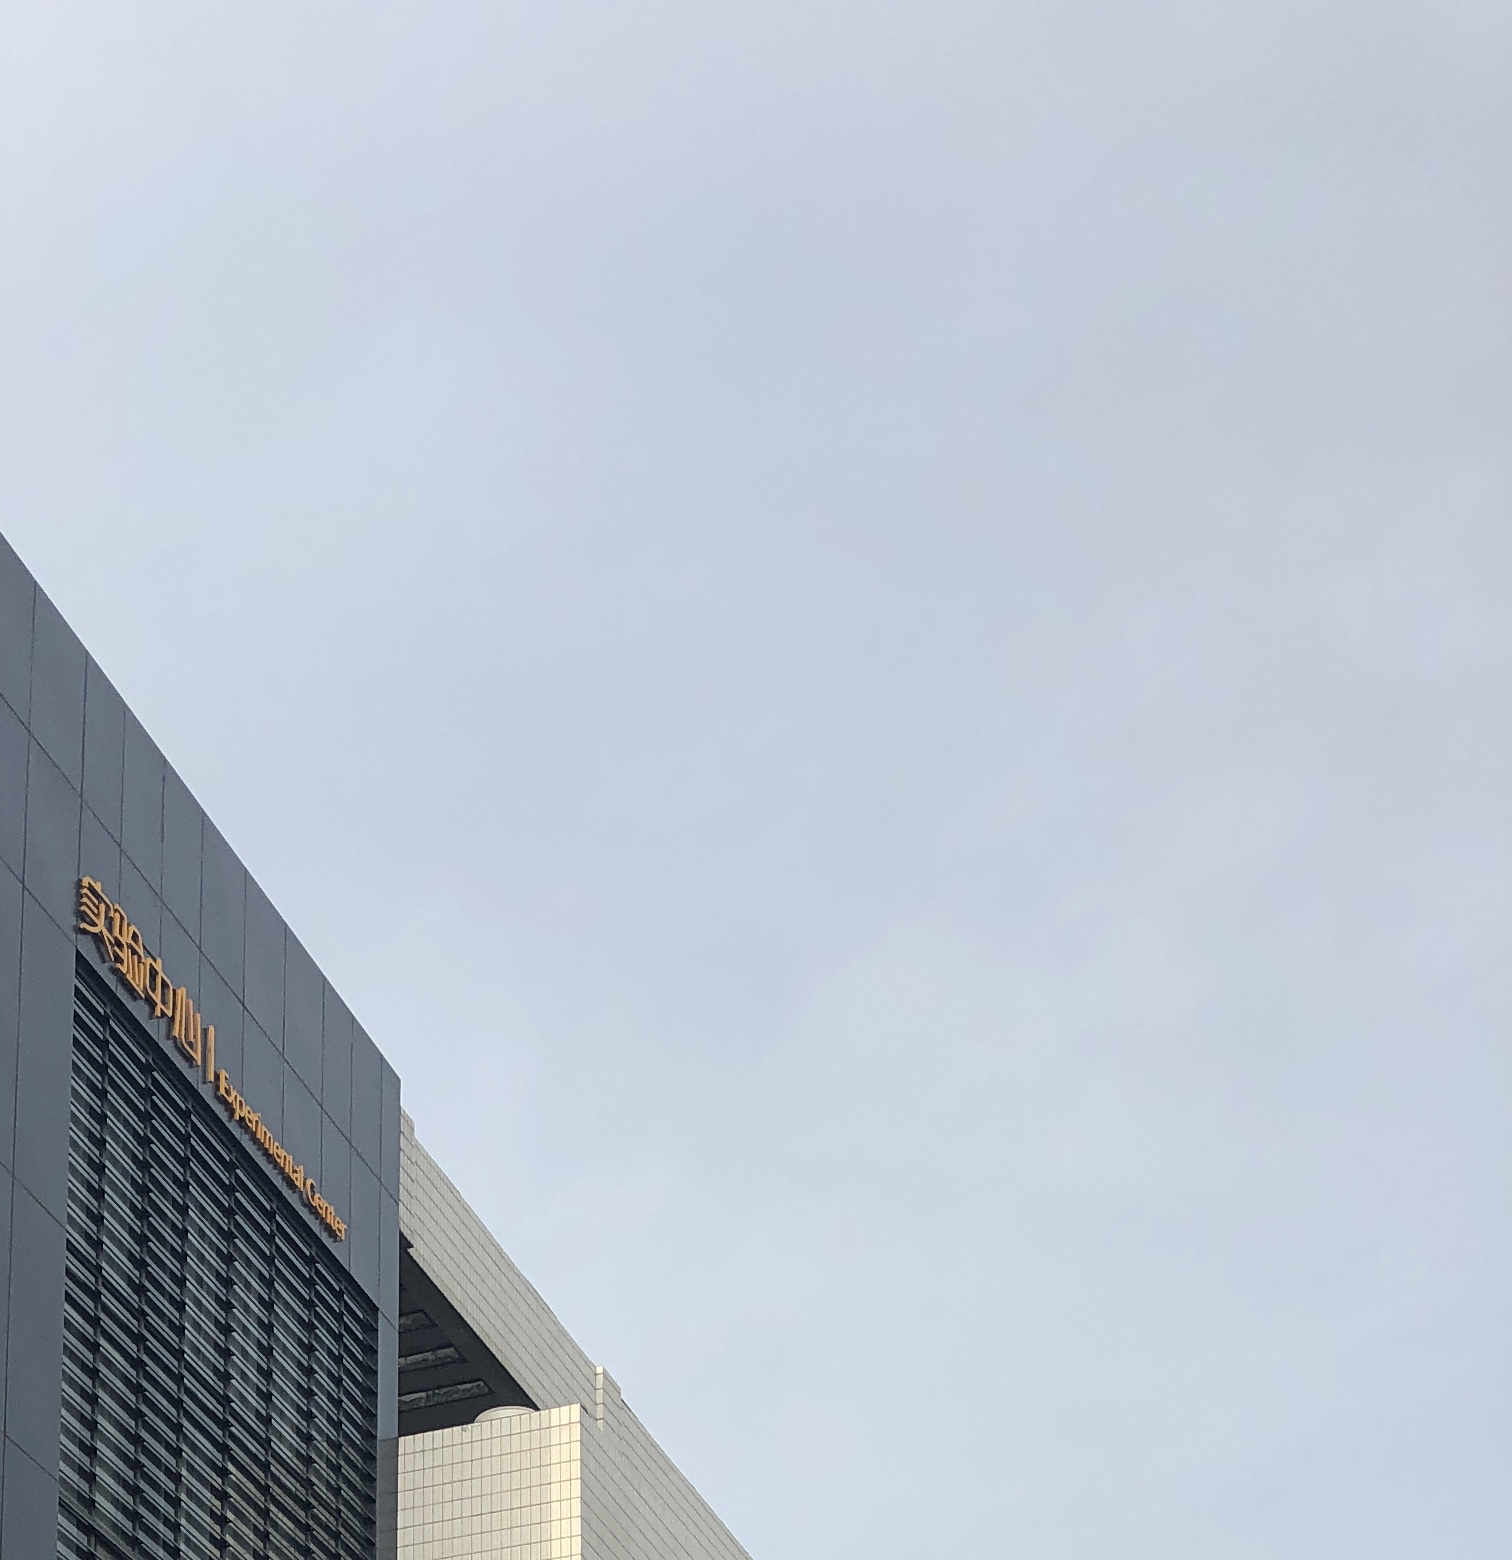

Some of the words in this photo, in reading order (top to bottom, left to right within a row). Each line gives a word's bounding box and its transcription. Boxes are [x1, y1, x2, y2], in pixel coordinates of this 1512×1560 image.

[79, 875, 202, 1067] 实验中心
[218, 1068, 304, 1192] Experimental
[305, 1178, 348, 1242] Center
